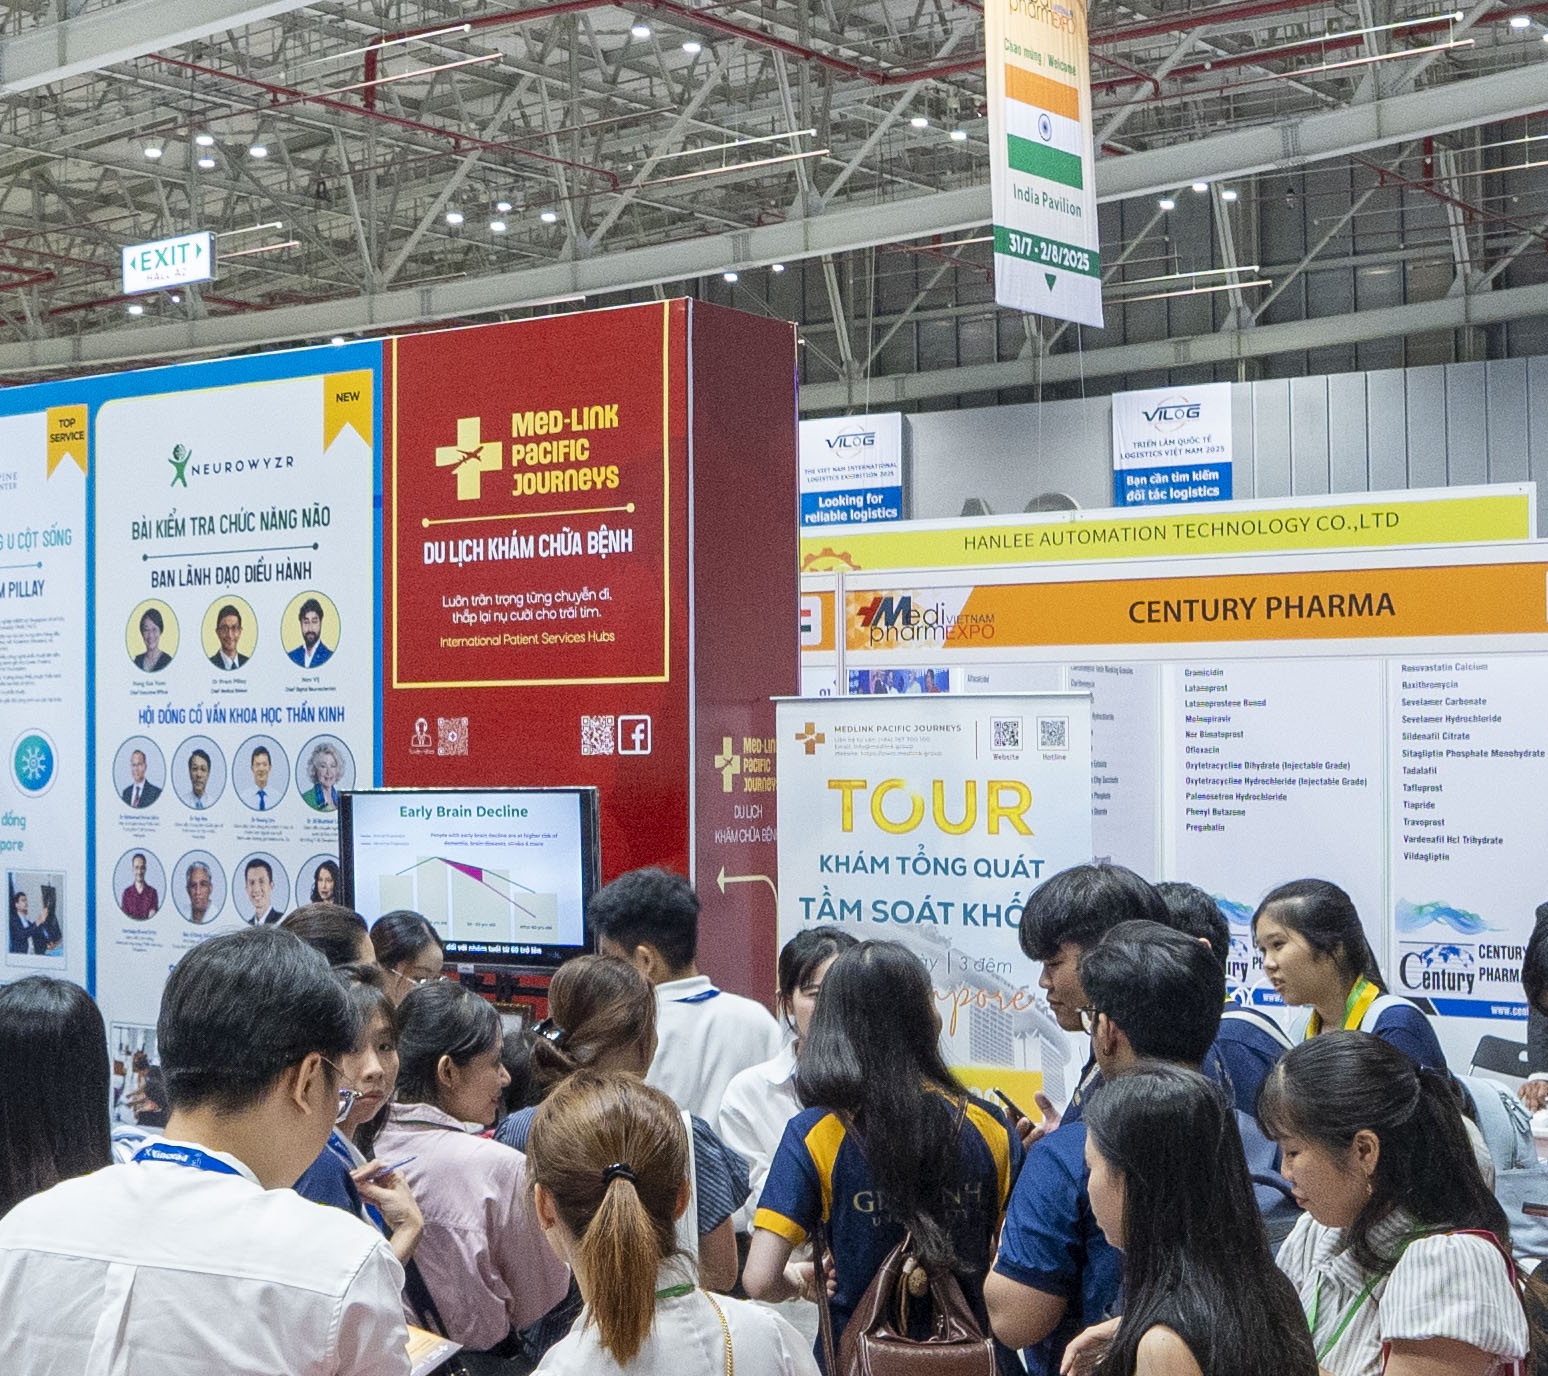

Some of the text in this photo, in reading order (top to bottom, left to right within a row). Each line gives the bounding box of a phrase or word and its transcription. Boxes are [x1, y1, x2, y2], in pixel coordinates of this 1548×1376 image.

[1013, 184, 1082, 217] India Pavilion
[141, 243, 190, 271] EXIT
[1009, 234, 1031, 255] 31/7
[1041, 242, 1089, 271] 2/8/2025
[335, 391, 360, 403] NEW
[192, 455, 294, 476] NEUROWYZR
[819, 493, 883, 508] Looking for
[805, 505, 897, 523] reliable logistics
[964, 532, 1034, 551] HANLEE
[1039, 526, 1166, 547] AUTOMATION
[1173, 515, 1311, 541] TECHNOLOGY
[424, 525, 632, 567] DU LỊCH KHÁM CHỮA BỆNH
[874, 596, 946, 625] Medi
[1128, 591, 1397, 624] CENTURY PHARMA
[946, 614, 995, 624] VIETNAM
[440, 630, 615, 647] International Patient Services Hubs
[870, 622, 946, 646] pharm
[946, 625, 995, 639] EXPO
[914, 724, 961, 732] JOURNEYS
[1403, 766, 1437, 775] Tadalafil
[400, 805, 528, 820] Early Brain Decline
[828, 778, 1034, 836] TOUR
[820, 842, 1045, 880] KHÁM TỔNG QUÁT
[1404, 852, 1450, 861] Vildagliptin
[799, 884, 954, 925] TẦM SOÁT
[959, 955, 1012, 974] 3 đêm
[1400, 943, 1474, 994] Century
